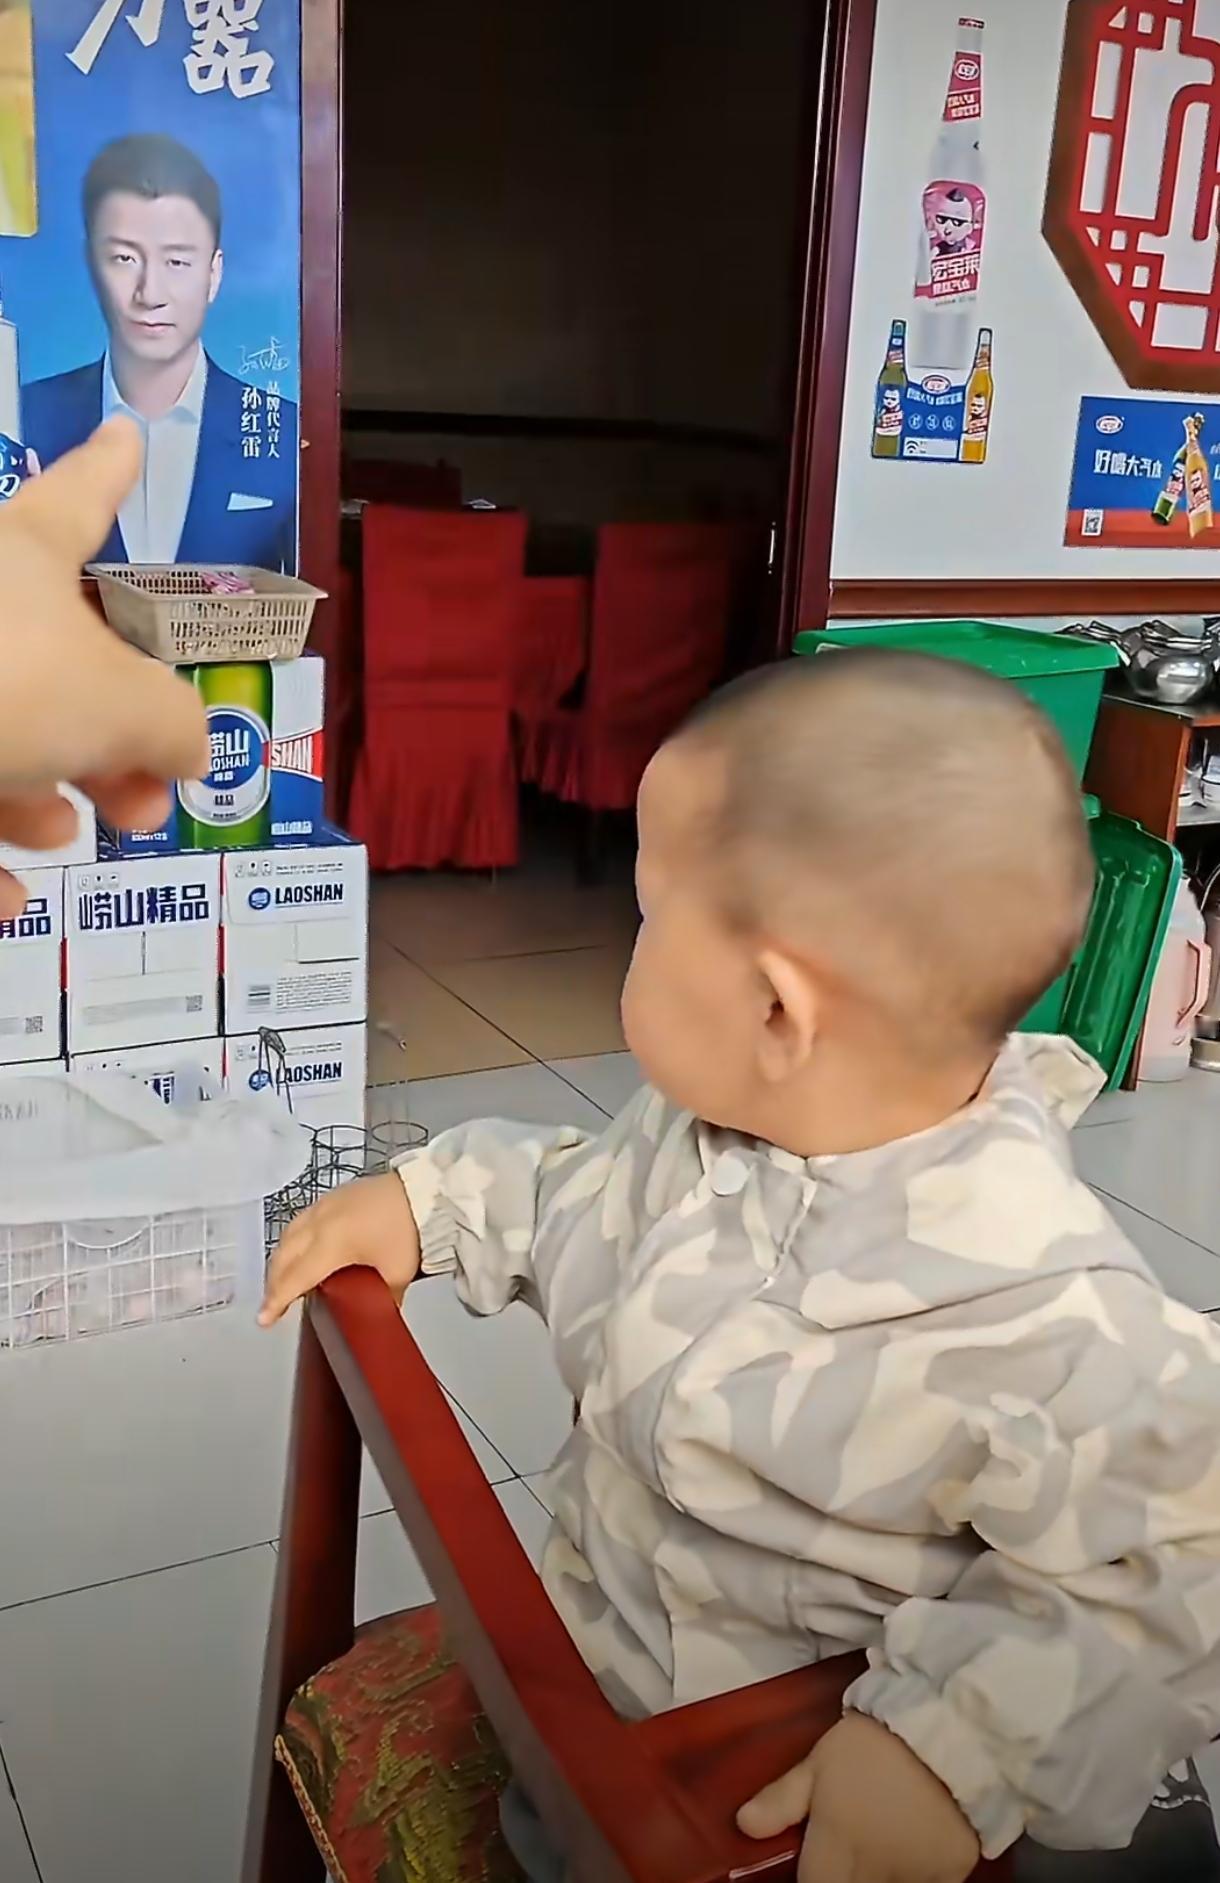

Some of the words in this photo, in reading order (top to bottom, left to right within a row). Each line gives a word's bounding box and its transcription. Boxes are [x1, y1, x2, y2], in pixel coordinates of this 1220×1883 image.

[241, 387, 262, 458] 孙红雷
[79, 884, 209, 930] 崂山精品
[275, 883, 344, 904] LAOSHAN
